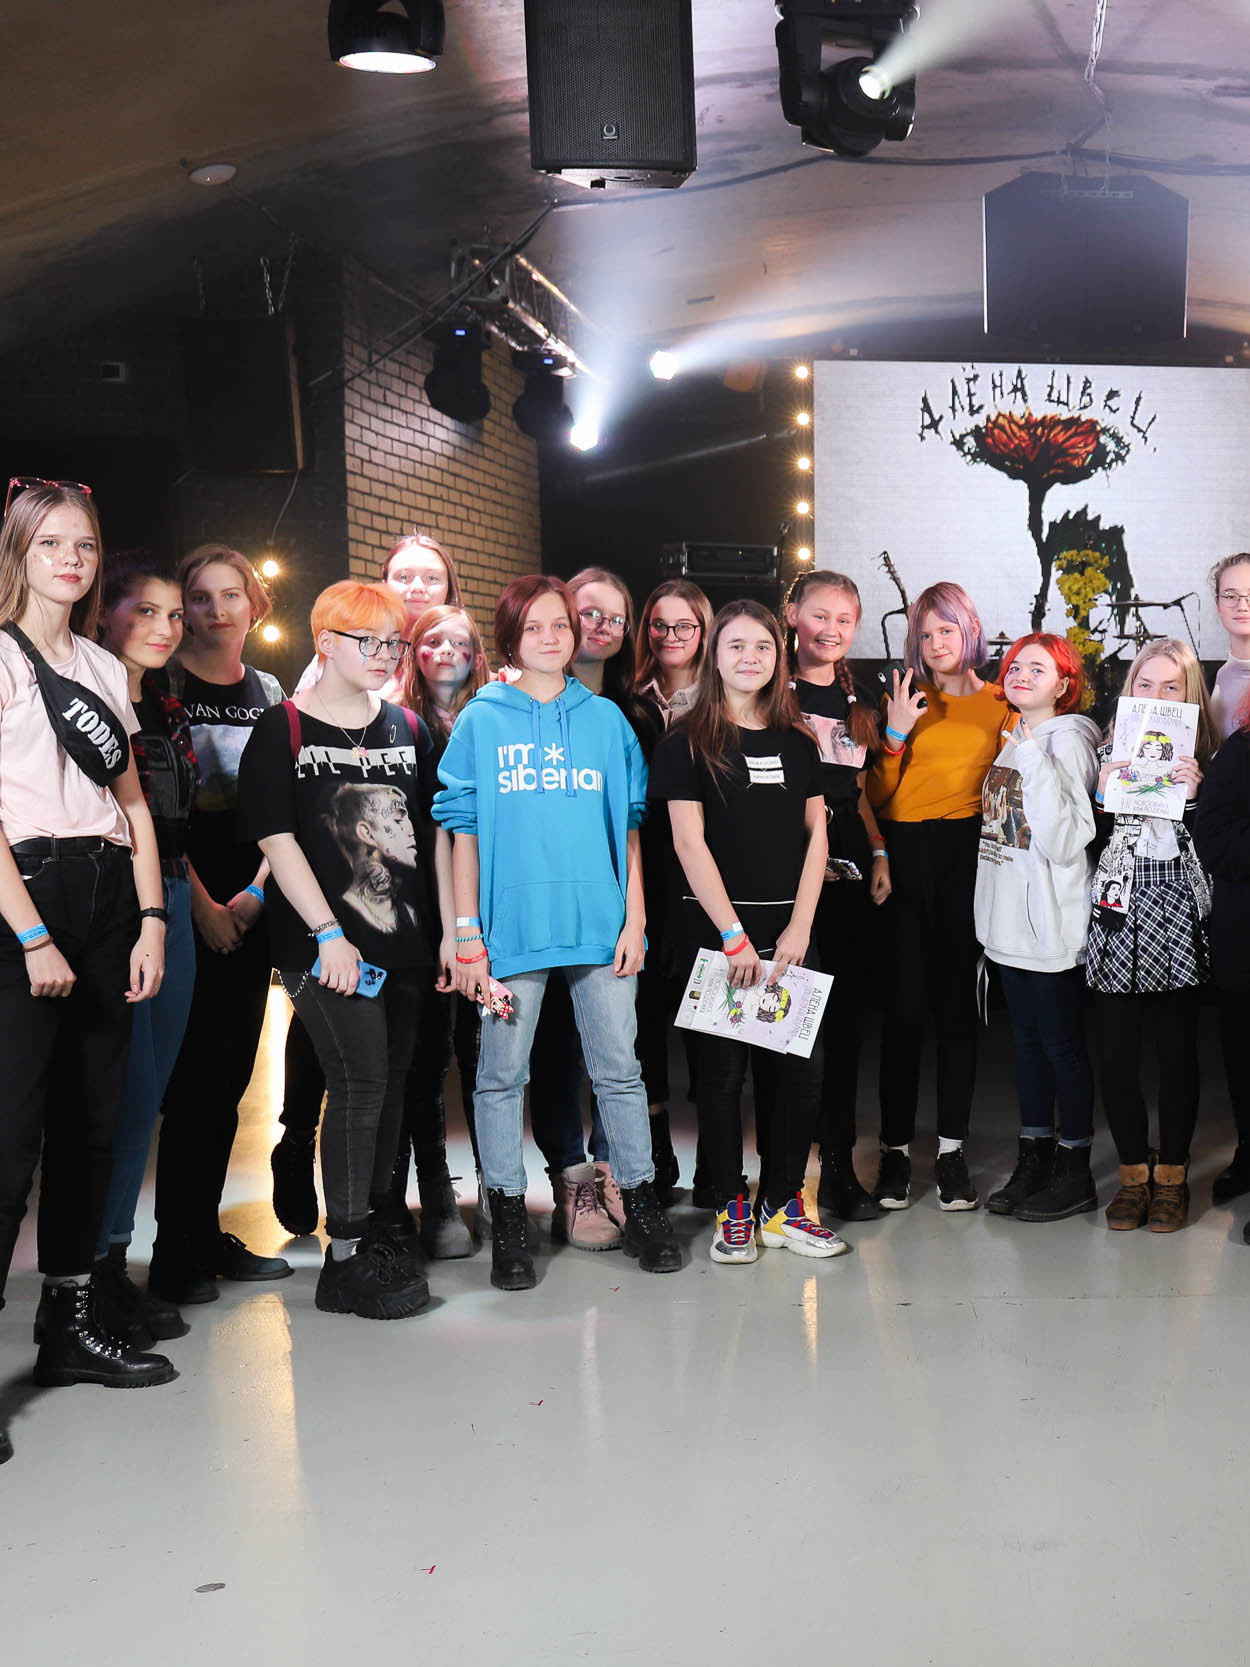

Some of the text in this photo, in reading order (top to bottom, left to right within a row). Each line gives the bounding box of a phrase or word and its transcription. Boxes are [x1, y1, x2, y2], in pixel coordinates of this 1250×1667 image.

[918, 362, 1157, 453] АЛЁНА ШВЕЦ
[184, 703, 264, 720] VAN GOG
[1131, 703, 1159, 715] АЛЕА
[62, 697, 122, 769] TODES
[358, 751, 418, 778] PEE
[497, 743, 535, 768] I'm
[498, 763, 603, 793] siberian
